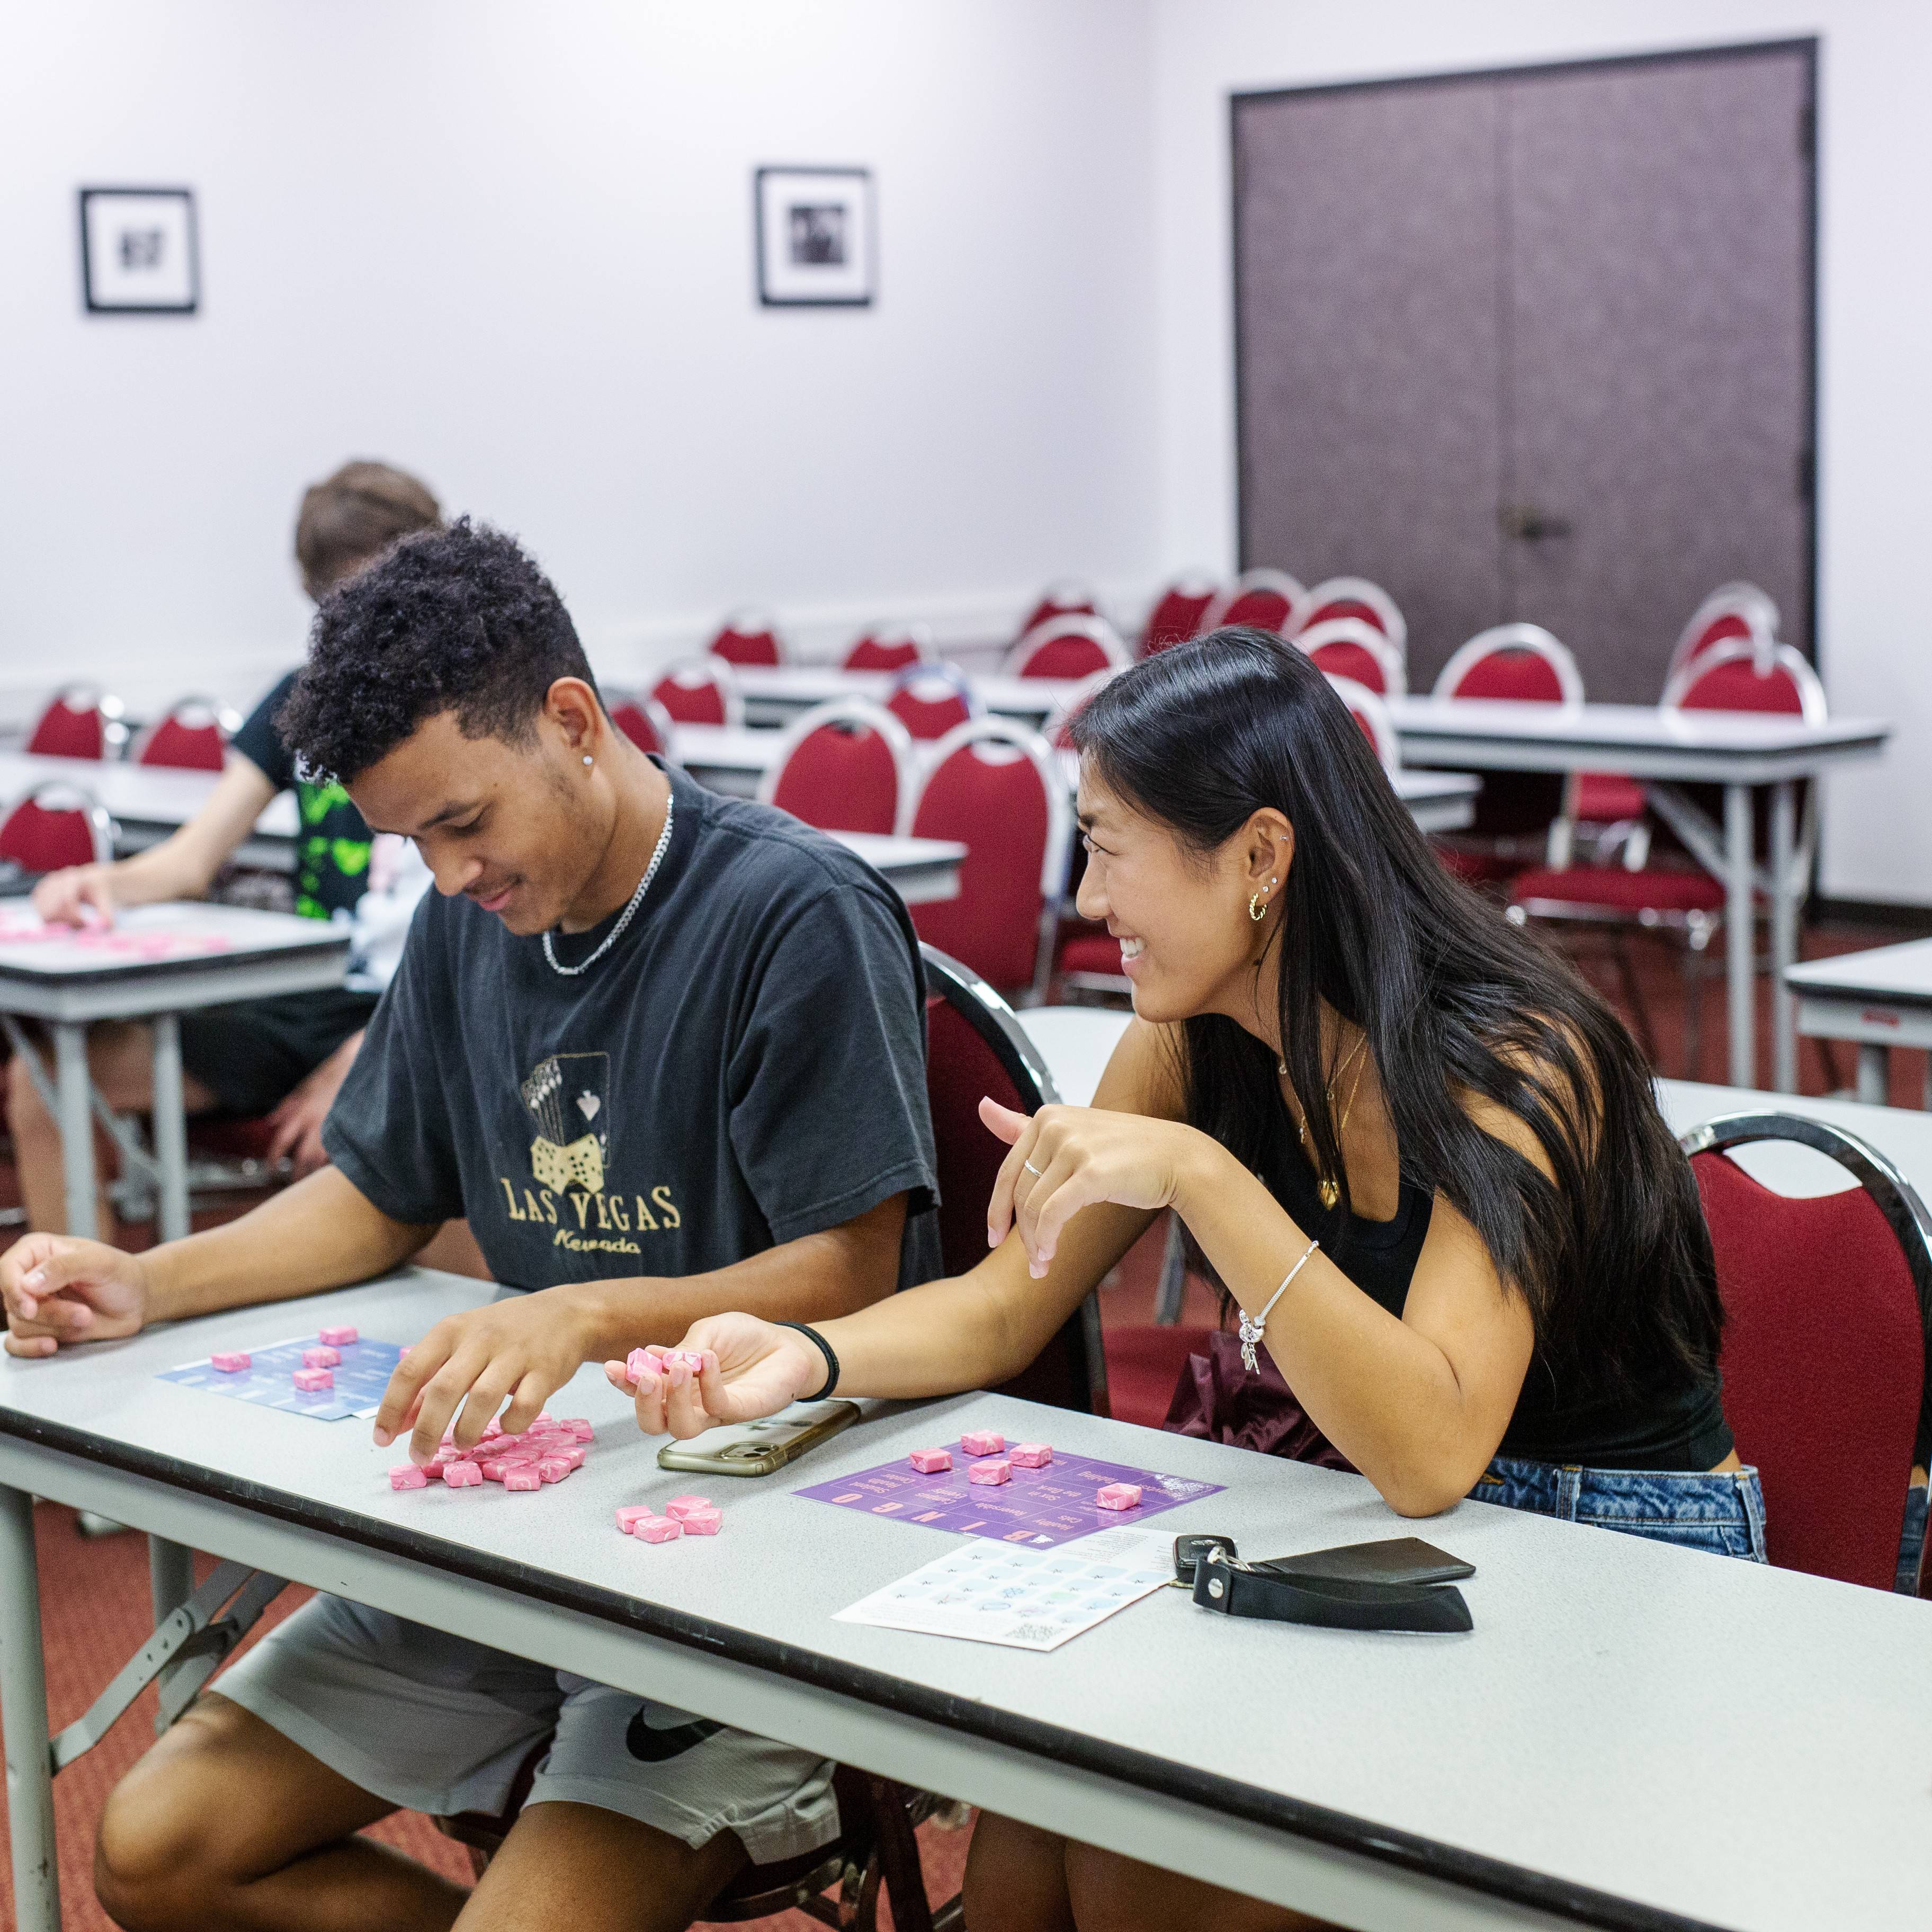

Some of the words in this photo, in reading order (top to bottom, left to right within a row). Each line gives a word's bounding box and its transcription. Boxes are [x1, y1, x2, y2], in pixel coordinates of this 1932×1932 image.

[500, 1178, 557, 1224] LAS
[569, 1186, 681, 1231] VEGAS
[553, 1228, 641, 1254] Nevada
[868, 1478, 902, 1488] Health
[881, 1473, 916, 1483] Center
[1077, 1471, 1119, 1483] Tabling
[848, 1481, 890, 1493] Student
[1036, 1484, 1064, 1493] Dark
[915, 1492, 957, 1504] Campus
[933, 1488, 969, 1499] Events
[975, 1502, 1027, 1516] Reversible
[1033, 1518, 1075, 1530] Healthy
[1057, 1515, 1083, 1523] Cats
